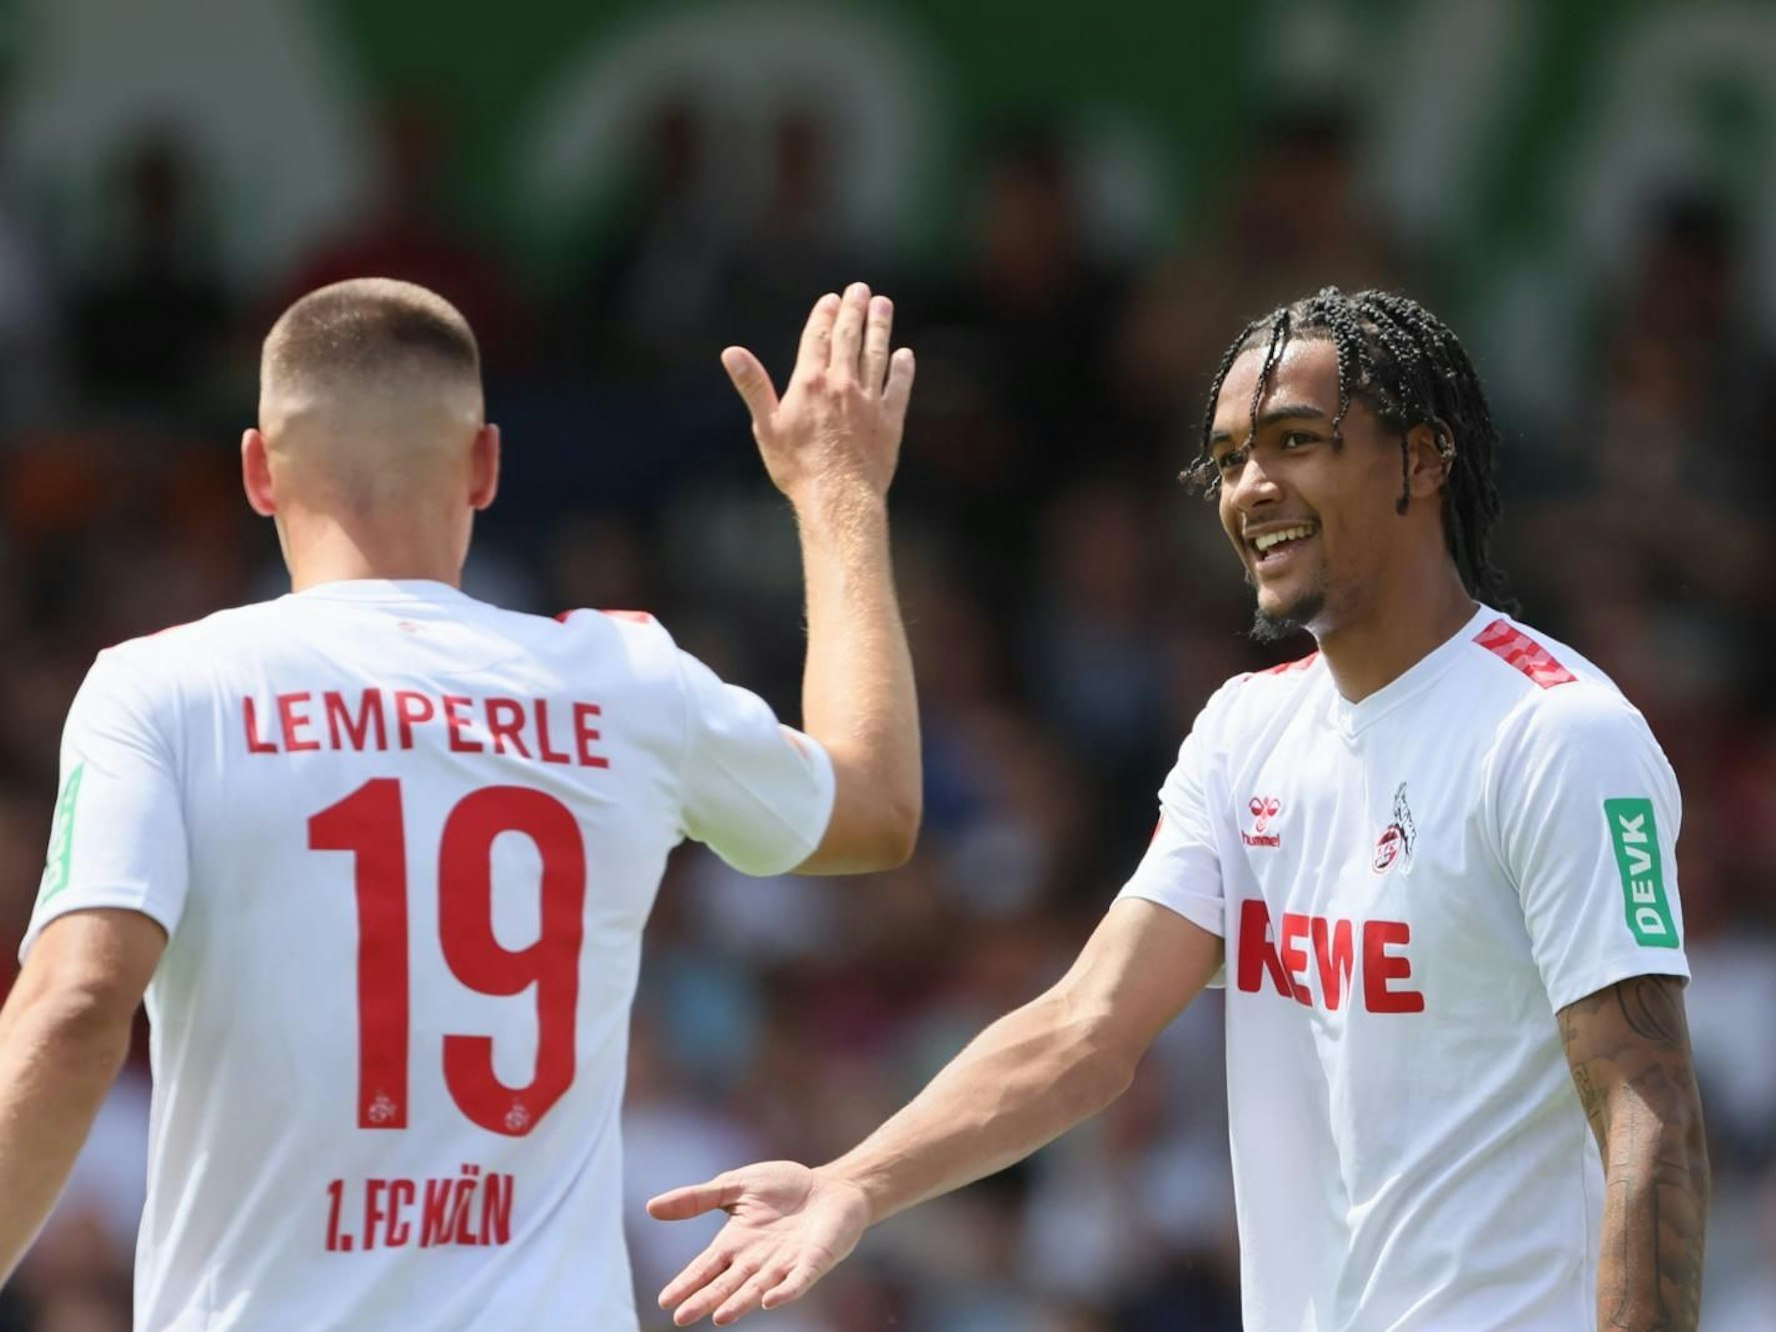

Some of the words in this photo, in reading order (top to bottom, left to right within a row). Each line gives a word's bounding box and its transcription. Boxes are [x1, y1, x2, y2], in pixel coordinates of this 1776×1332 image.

[243, 689, 609, 769] LEMPERLE
[1618, 813, 1667, 934] DEVK
[308, 778, 586, 1136] 19
[1237, 899, 1425, 1014] REWE
